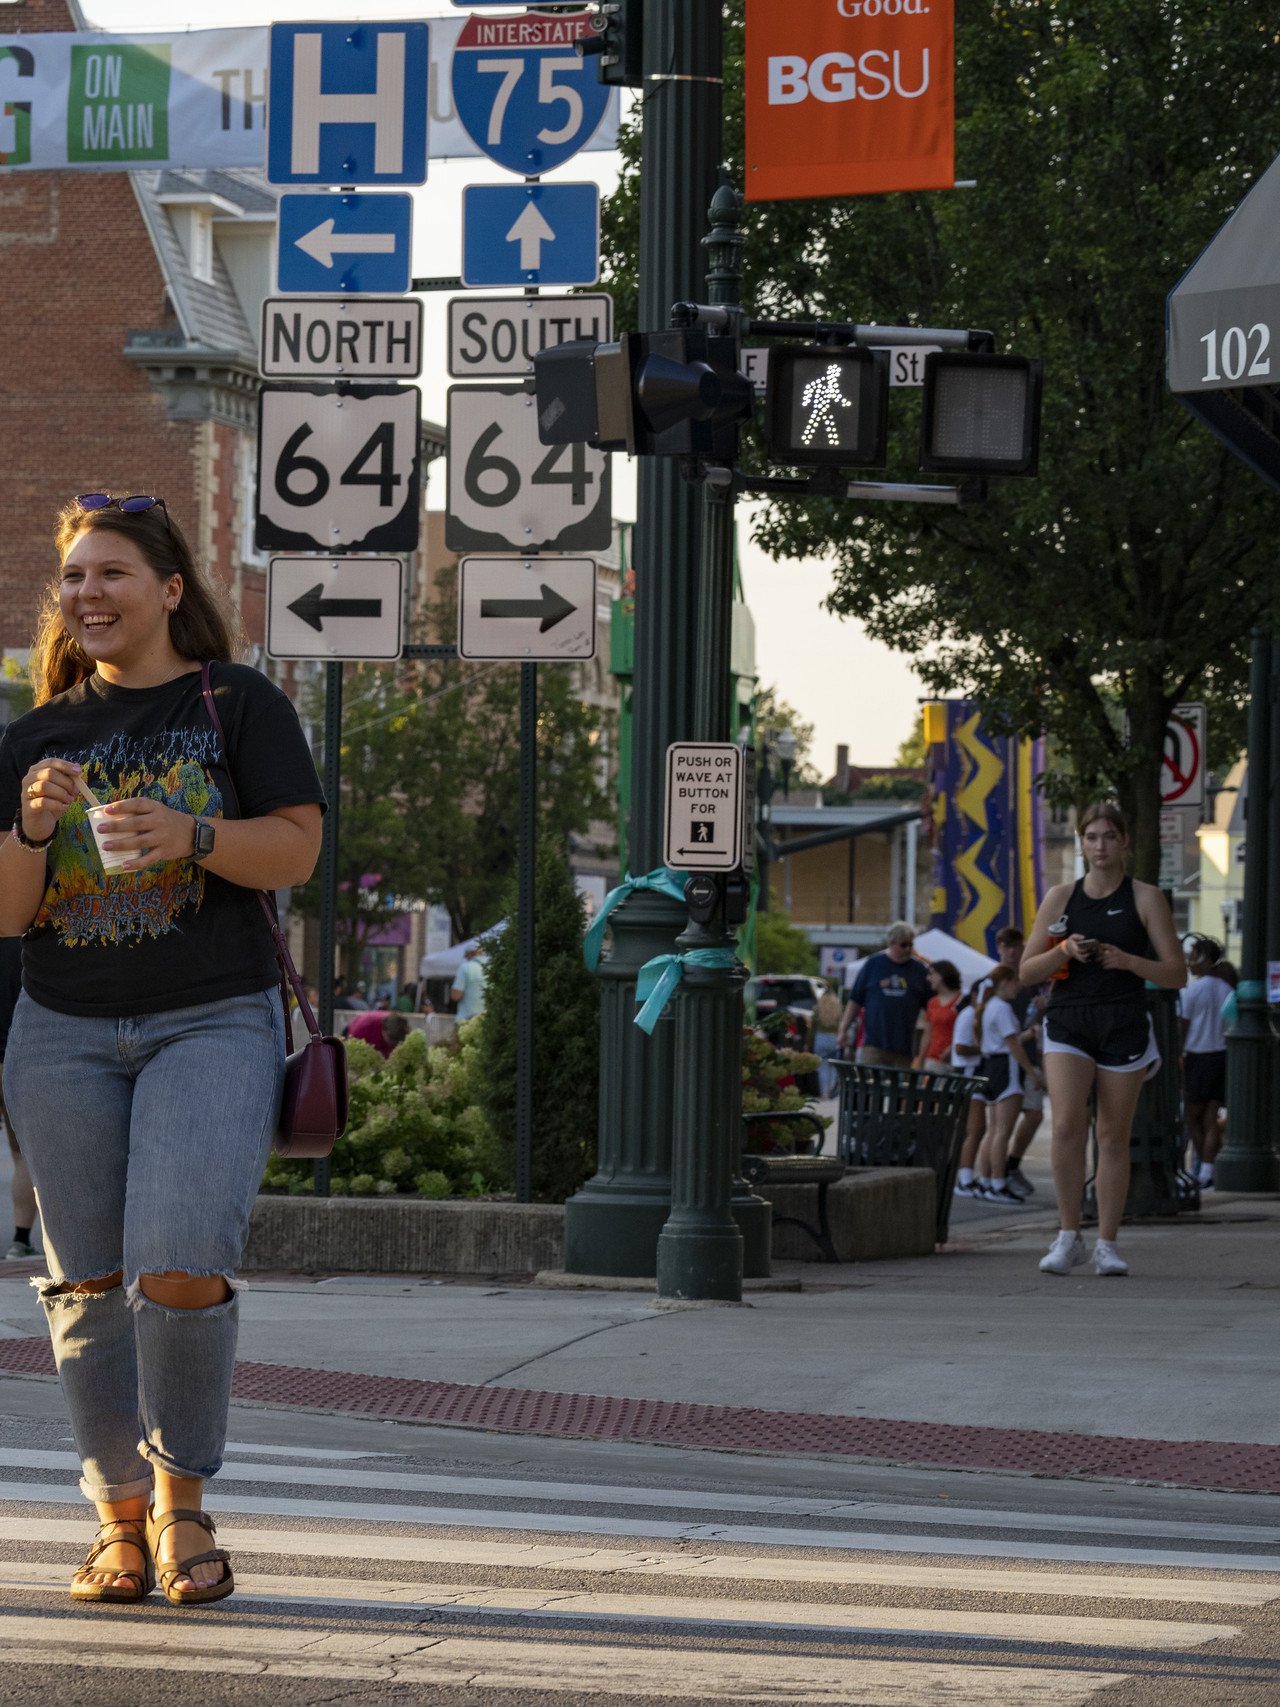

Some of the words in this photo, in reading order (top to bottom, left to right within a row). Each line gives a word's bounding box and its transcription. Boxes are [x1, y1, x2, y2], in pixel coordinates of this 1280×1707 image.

[477, 22, 585, 43] INTERSTATE
[84, 55, 124, 99] ON
[477, 57, 583, 145] 75
[768, 48, 930, 105] BGSU
[82, 104, 155, 150] MAIN
[291, 32, 406, 174] H
[272, 312, 412, 364] NORTH
[1200, 322, 1271, 383] 102
[275, 422, 401, 507] 64
[464, 421, 594, 507] 64
[676, 772, 712, 783] WAVE
[715, 773, 733, 783] AT
[677, 757, 711, 767] PUSH
[714, 757, 731, 767] OR
[678, 788, 729, 798] BUTTON
[690, 804, 716, 814] FOR
